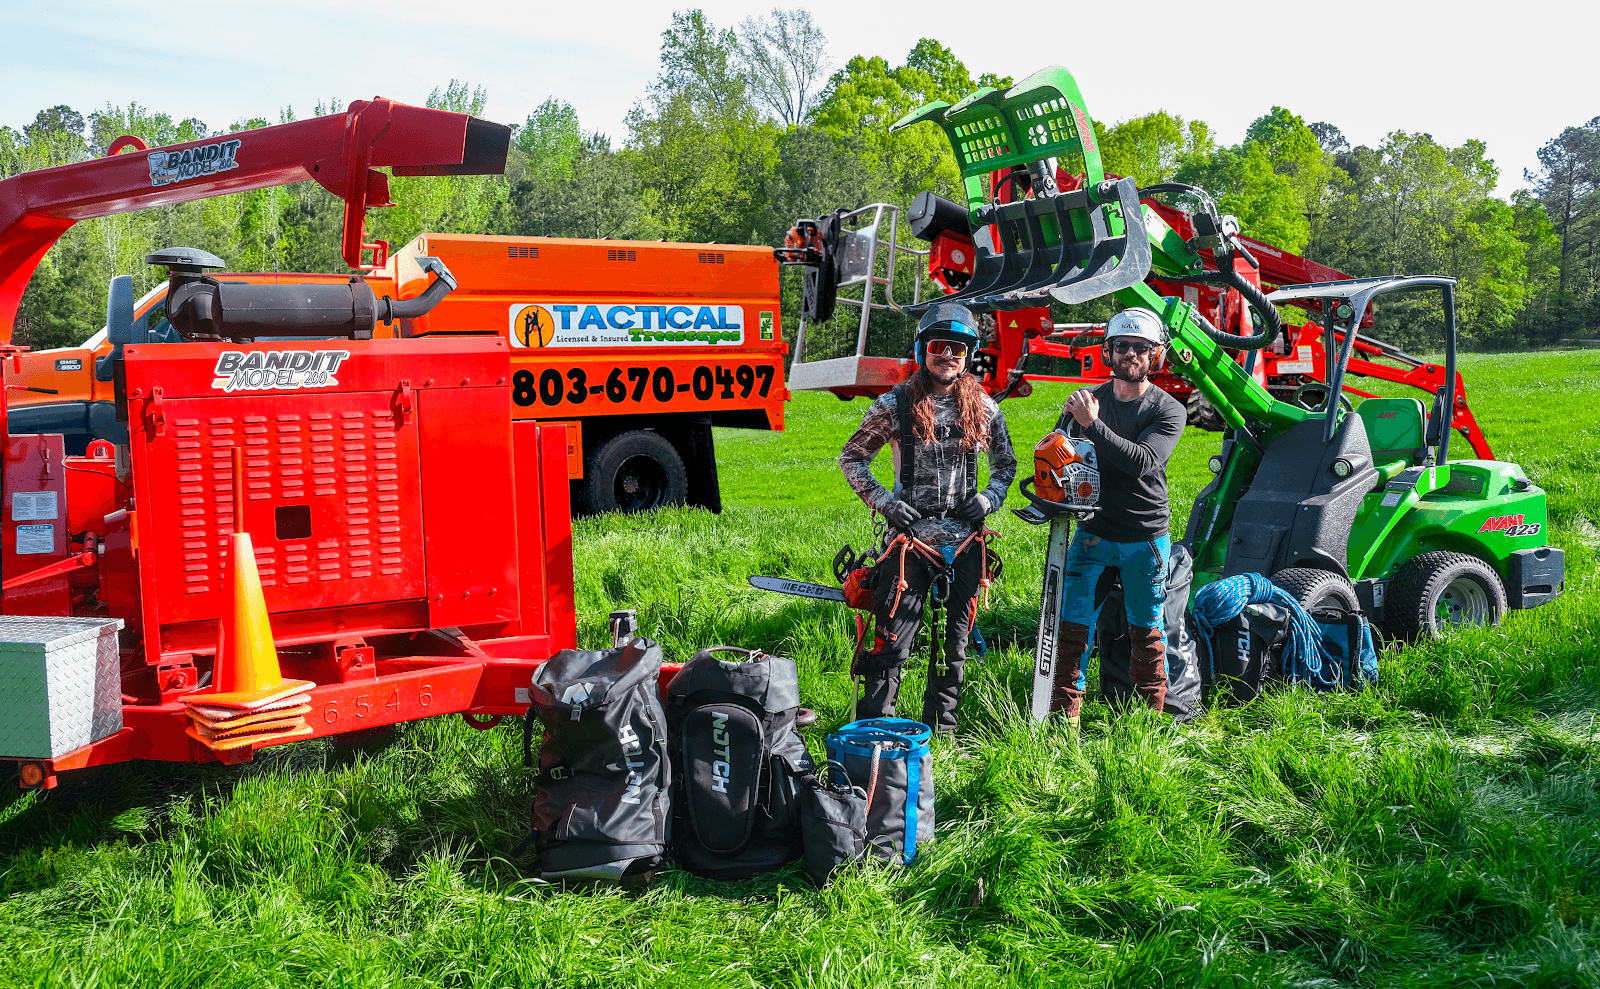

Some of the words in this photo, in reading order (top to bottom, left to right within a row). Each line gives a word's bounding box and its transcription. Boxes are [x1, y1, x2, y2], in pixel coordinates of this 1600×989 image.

[1071, 103, 1096, 152] AVANT
[168, 141, 240, 169] BANDIT
[175, 159, 216, 181] MODEL
[218, 157, 232, 169] 200
[553, 305, 741, 330] TACTICAL
[556, 335, 589, 343] Licensed
[600, 334, 629, 342] Insured
[628, 328, 741, 345] Treescapes
[216, 351, 349, 374] BANDIT
[226, 368, 300, 391] MODEL
[303, 370, 328, 386] 200
[512, 364, 775, 407] 803-670-0497
[1476, 513, 1525, 533] AVANT
[1504, 523, 1541, 537] 423
[1040, 631, 1053, 673] STIHL
[1237, 629, 1251, 662] TCH
[323, 684, 433, 725] 6546
[619, 723, 645, 805] NOTCH
[711, 711, 730, 794] NOTCH
